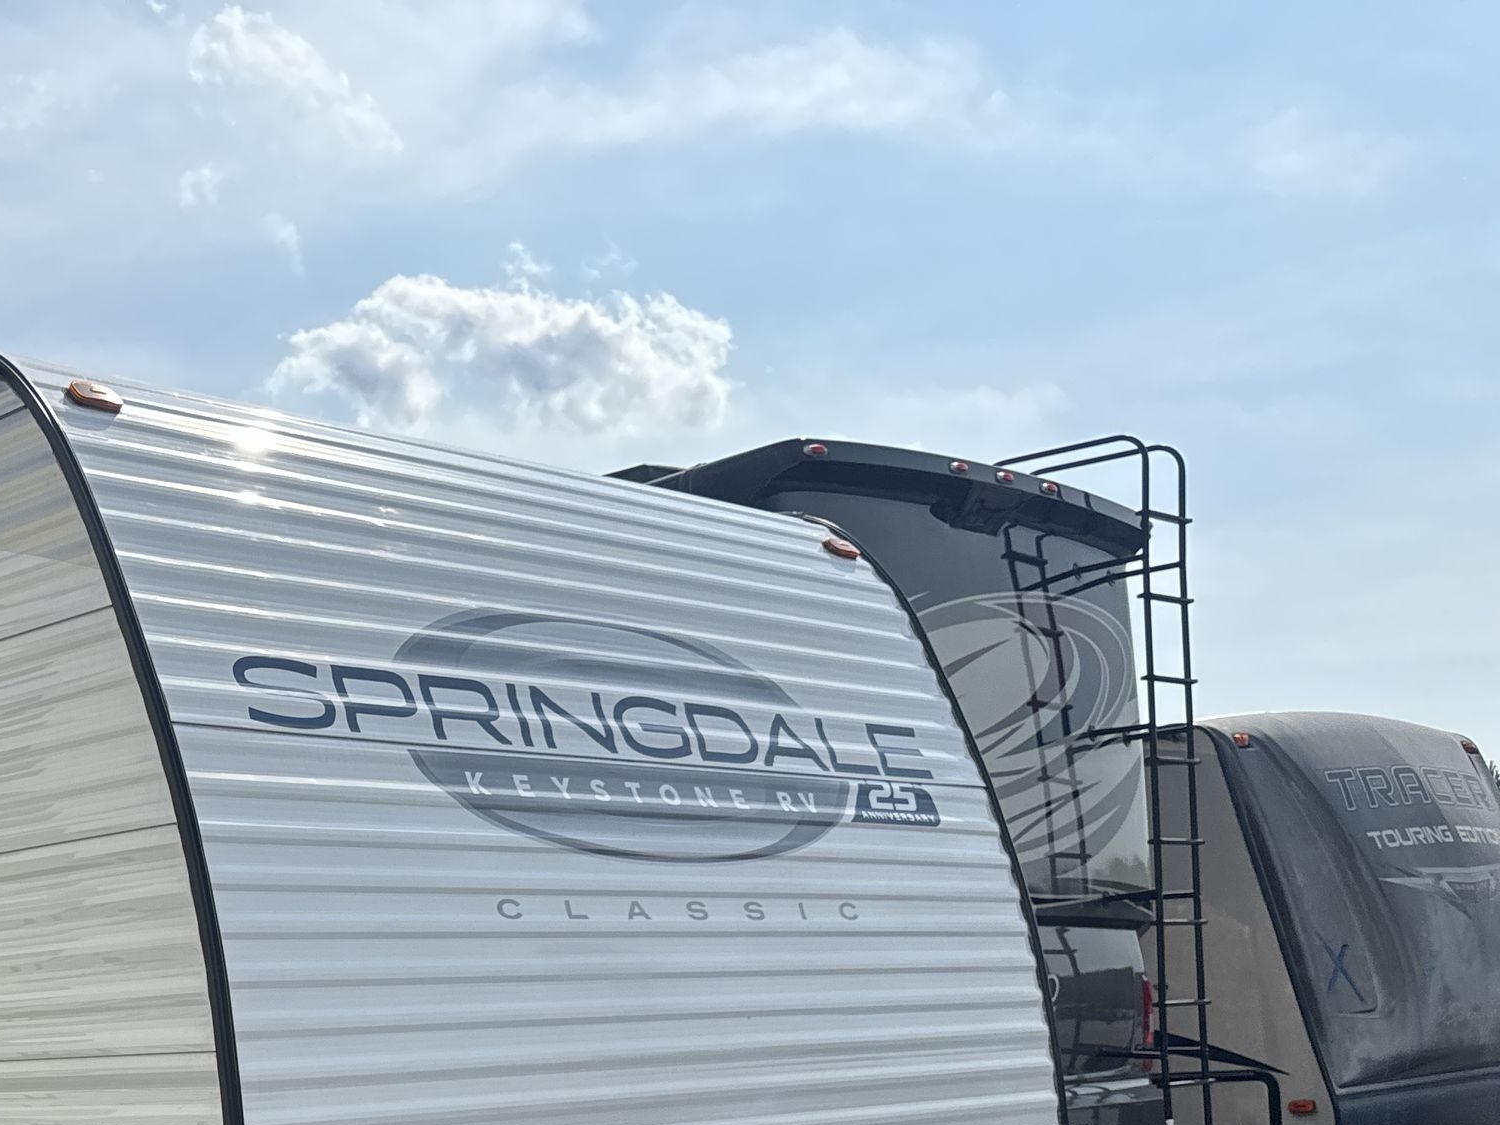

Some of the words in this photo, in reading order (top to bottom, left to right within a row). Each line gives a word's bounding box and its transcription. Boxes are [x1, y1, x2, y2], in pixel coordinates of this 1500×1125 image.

[230, 655, 935, 781] SPRINGDALE
[464, 771, 752, 812] KEYSTONE
[775, 791, 819, 814] RV
[867, 780, 917, 811] 25
[1324, 765, 1498, 813] TRACER
[861, 811, 935, 822] ANNIVERSARY
[1366, 825, 1455, 850] TOURING
[496, 898, 861, 921] CLASSIC
